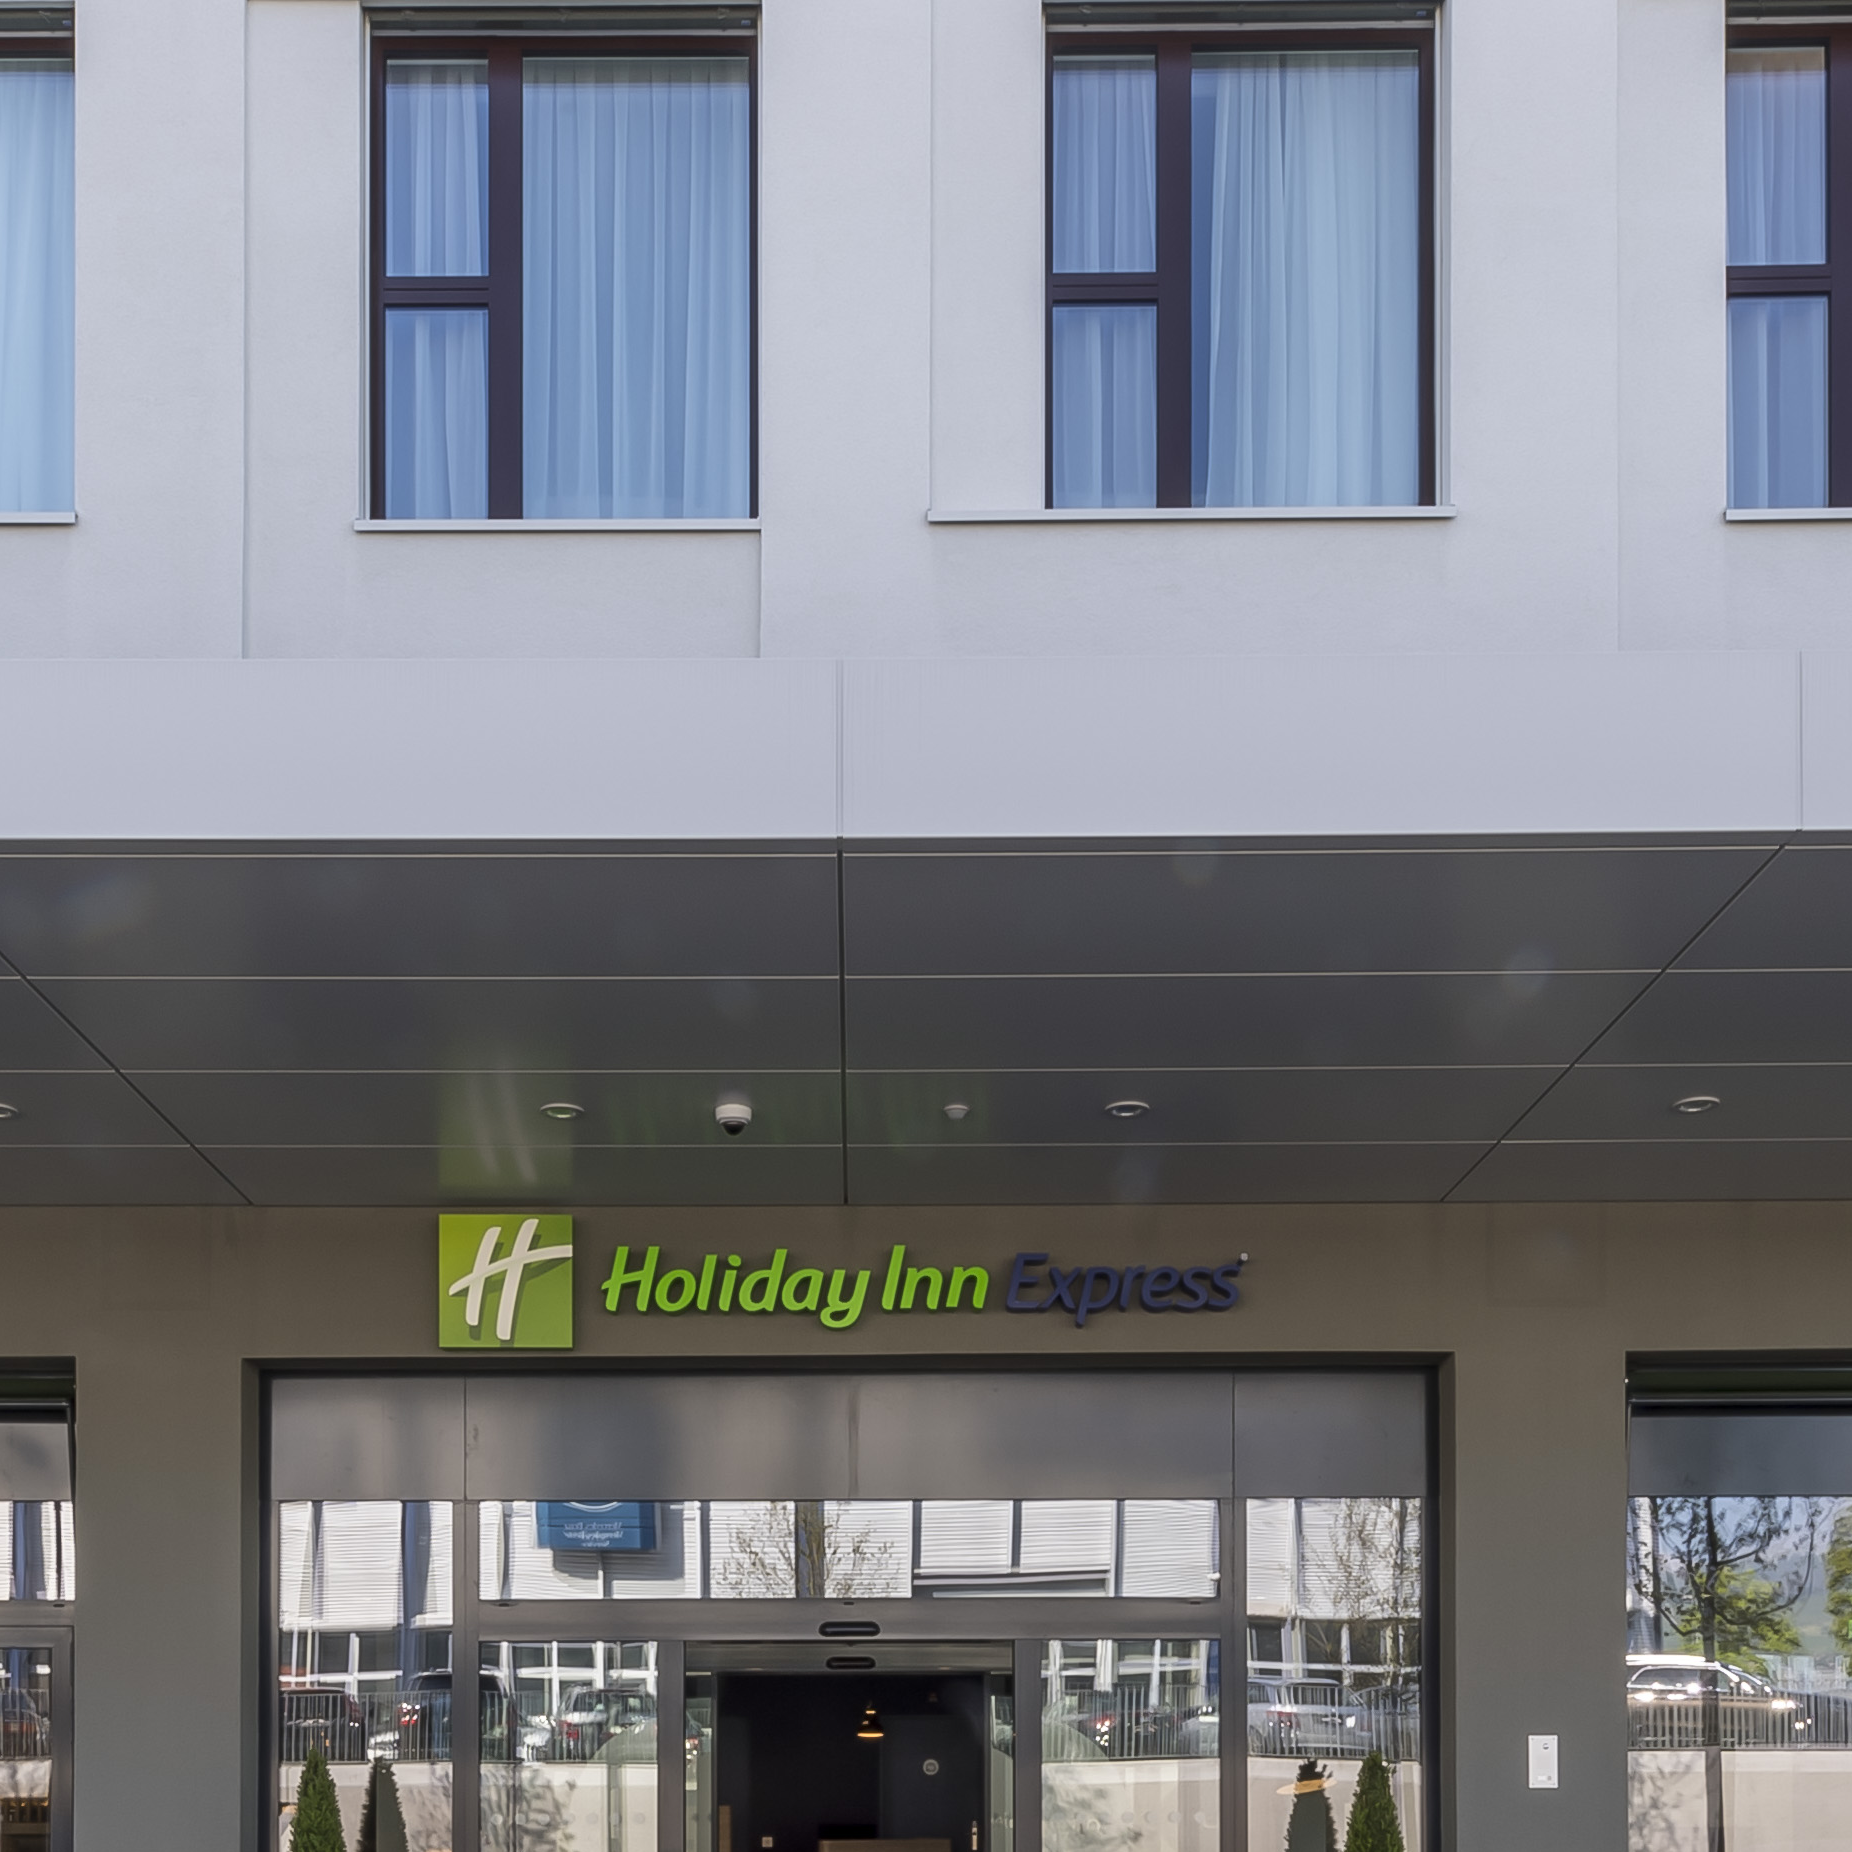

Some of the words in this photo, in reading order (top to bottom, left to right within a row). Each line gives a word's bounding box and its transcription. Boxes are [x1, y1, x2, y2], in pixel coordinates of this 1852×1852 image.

[601, 1245, 872, 1329] Holiday
[880, 1244, 990, 1312] Inn
[1005, 1252, 1242, 1328] Express
